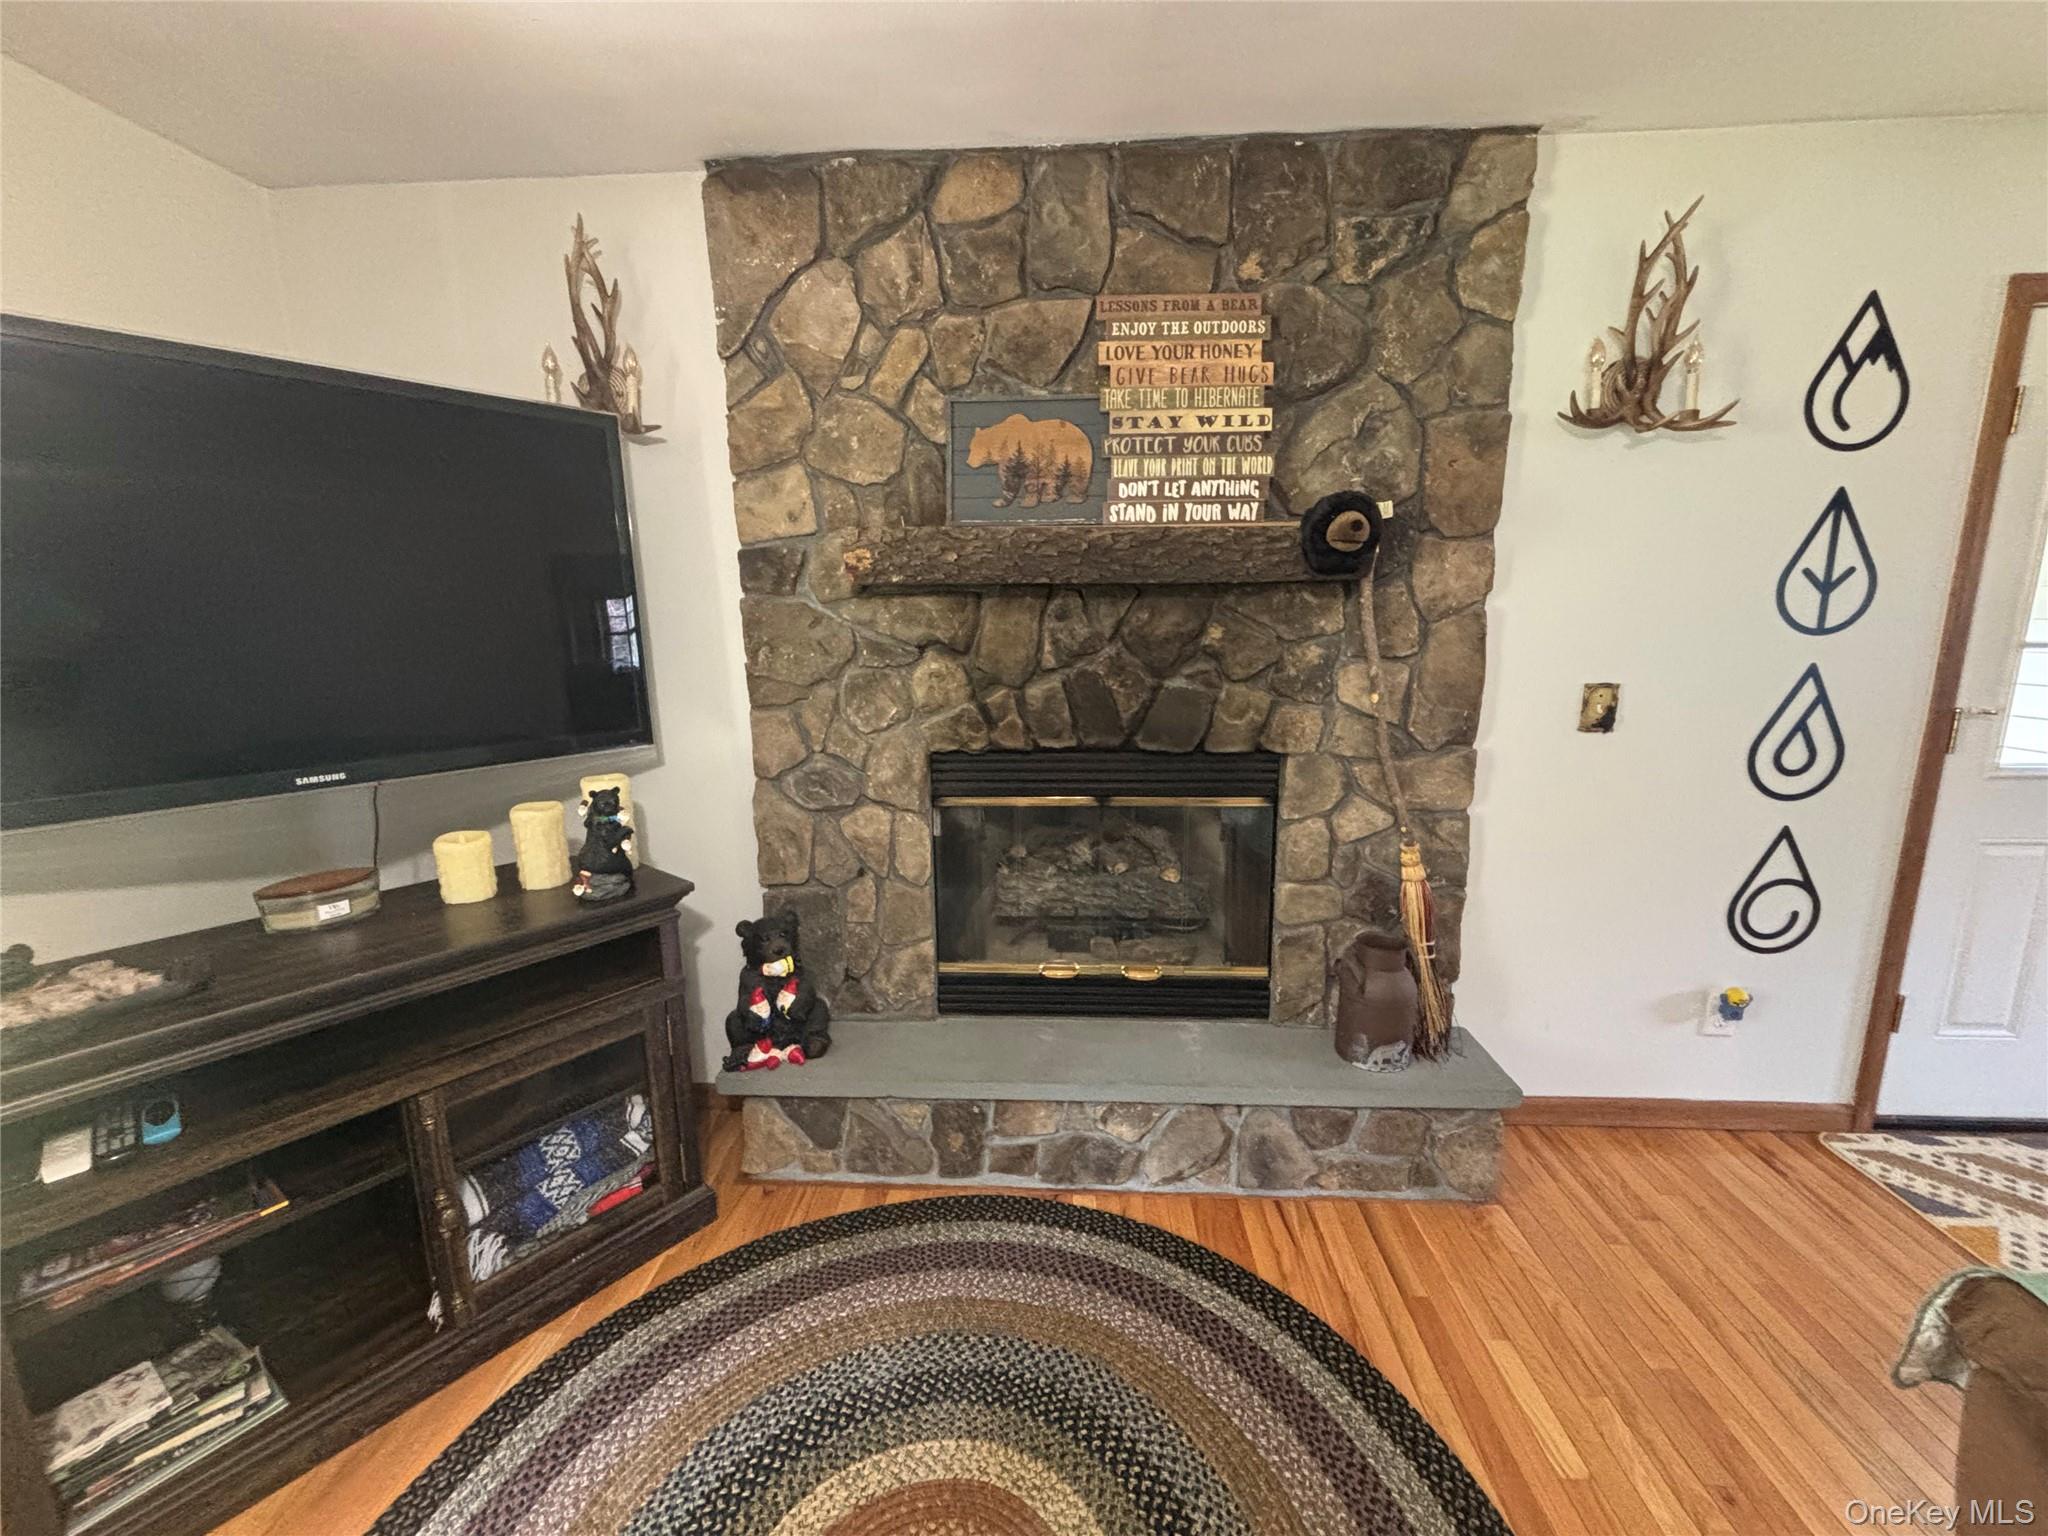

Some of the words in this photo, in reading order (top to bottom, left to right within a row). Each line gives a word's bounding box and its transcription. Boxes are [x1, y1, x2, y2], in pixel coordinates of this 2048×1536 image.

[1100, 301, 1157, 312] LESSONS
[1164, 301, 1200, 312] FROM
[1206, 300, 1216, 311] A
[1222, 299, 1258, 311] BEAR
[1112, 322, 1156, 335] ENJOY
[1162, 321, 1189, 334] THE
[1194, 320, 1266, 334] OUTDOORS
[1106, 346, 1144, 360] LOVE
[1152, 345, 1194, 360] YOUR
[1200, 344, 1256, 358] HONEY
[1116, 368, 1155, 385] GIVE
[1170, 367, 1211, 384] BEAR
[1224, 366, 1269, 383] HUGS
[1104, 389, 1131, 409] TAKE
[1139, 388, 1167, 408] TIME
[1176, 388, 1188, 408] TO
[1194, 387, 1260, 407] HIBERNATE
[1112, 415, 1183, 429] STAY
[1196, 414, 1271, 427] WILD
[1104, 436, 1176, 454] PROTECT
[1183, 435, 1220, 453] YOUR
[1227, 434, 1262, 452] CUBS
[1113, 458, 1138, 477] LEAVE
[1144, 458, 1166, 476] YOUR
[1171, 457, 1196, 476] PRINT
[1203, 457, 1216, 475] ON
[1221, 457, 1236, 475] THE
[1241, 456, 1273, 474] WORLD
[1119, 480, 1159, 498] DON'T
[1164, 480, 1187, 498] LET
[1109, 503, 1156, 523] STAND
[1184, 503, 1221, 521] YOUR
[1228, 502, 1259, 521] WAY
[295, 772, 347, 786] SAMSUNG
